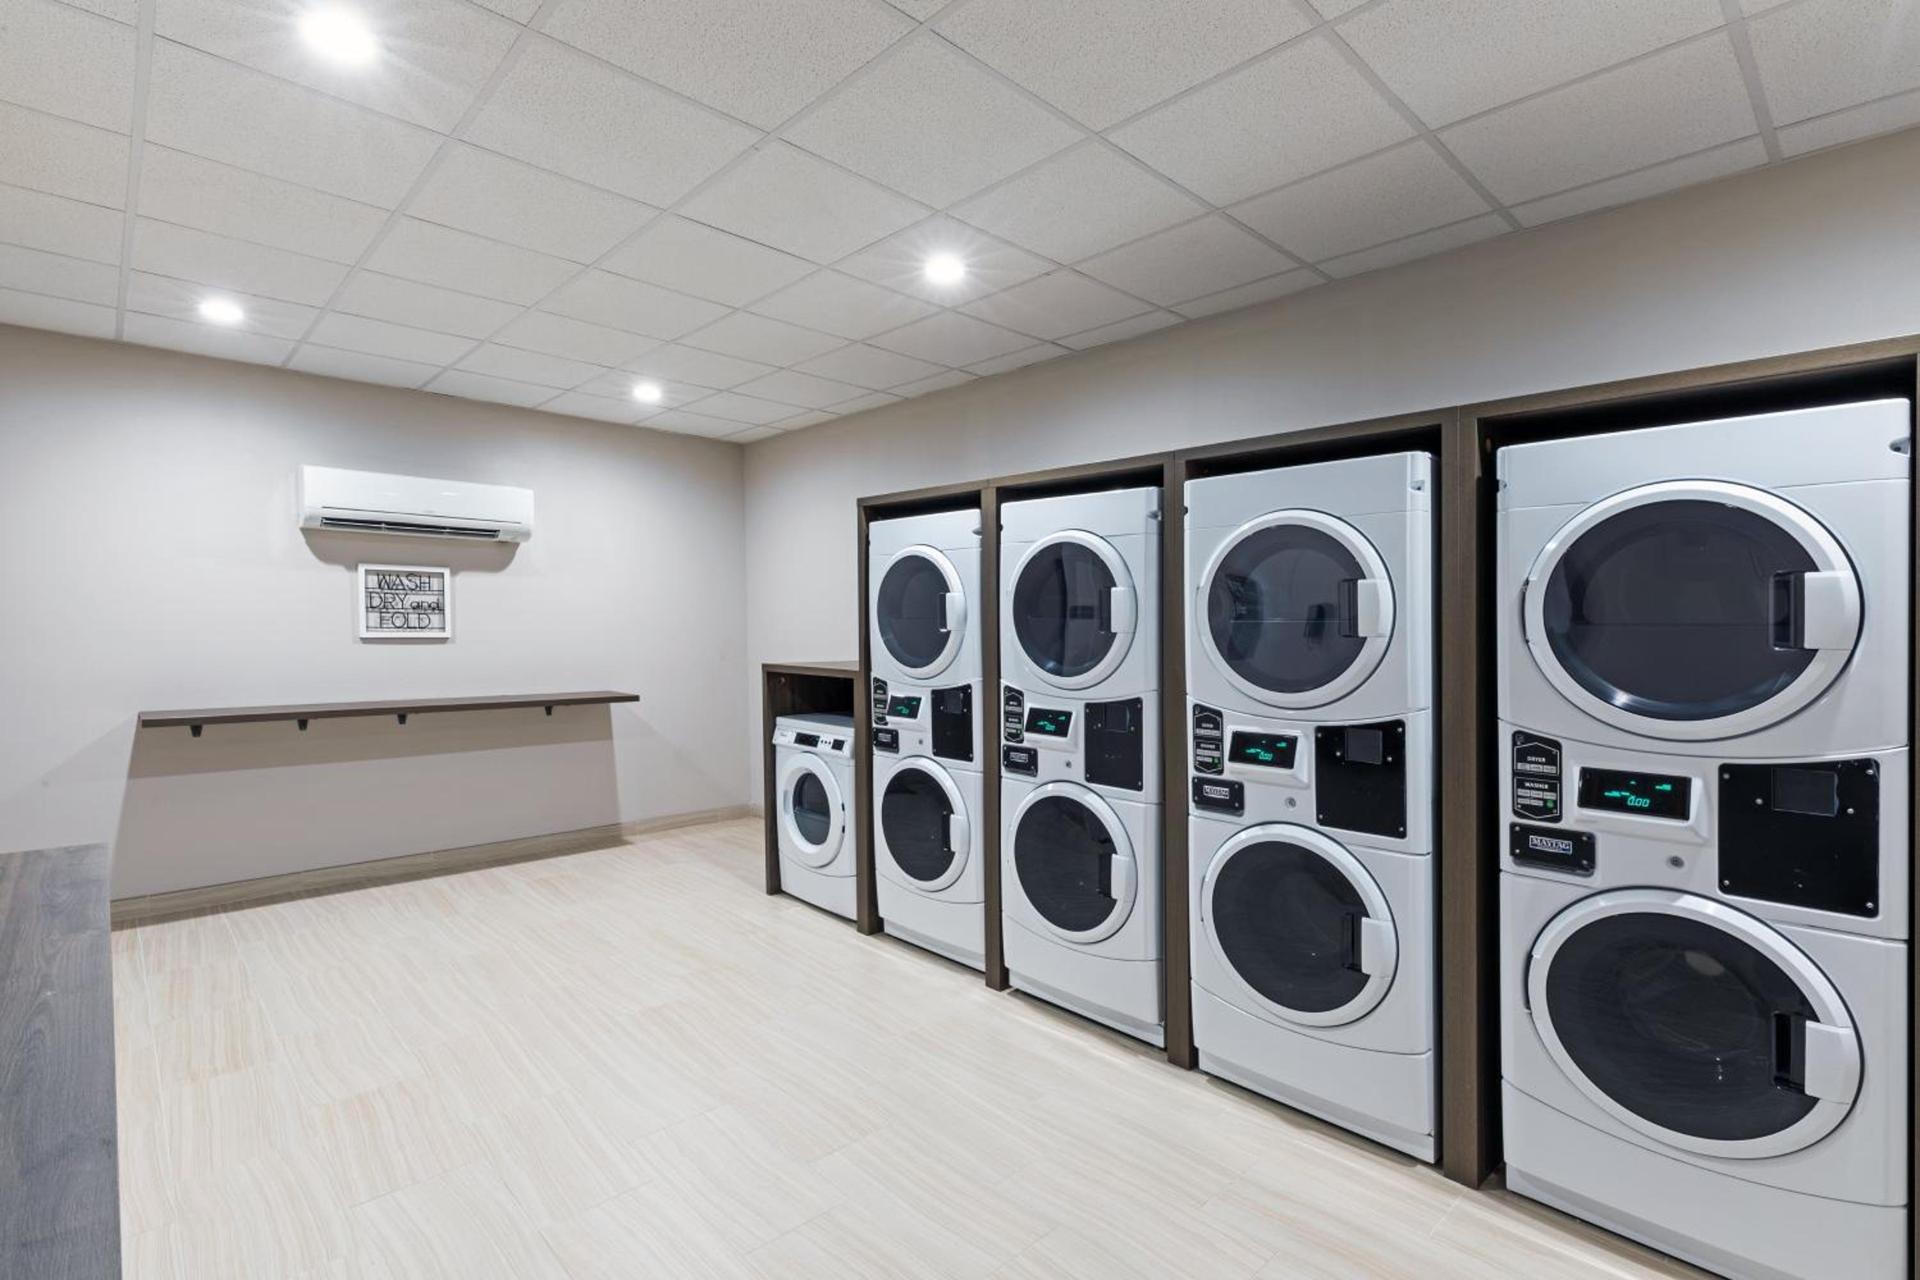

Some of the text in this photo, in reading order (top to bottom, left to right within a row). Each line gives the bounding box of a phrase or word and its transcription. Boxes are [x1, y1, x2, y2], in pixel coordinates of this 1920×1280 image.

[377, 573, 431, 591] WASH
[369, 591, 440, 610] DRY and
[380, 611, 431, 629] FOLD
[1531, 837, 1570, 851] MAYTAG
